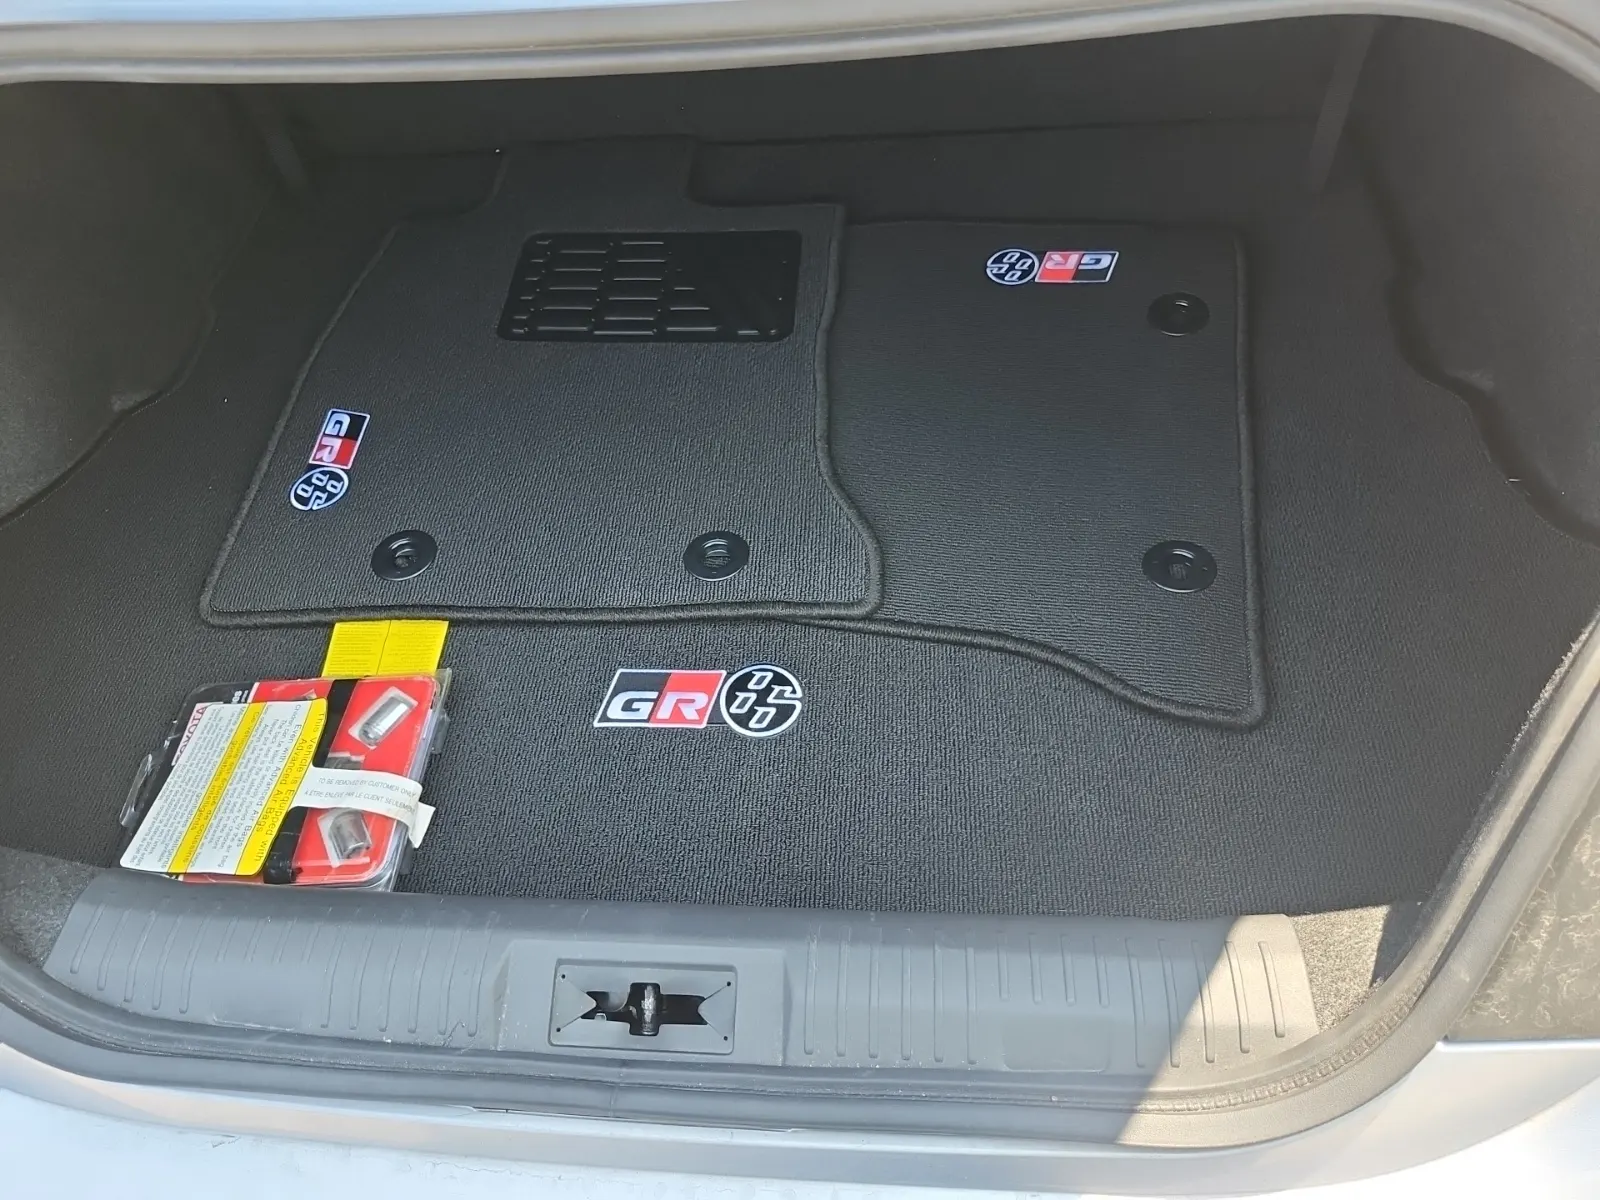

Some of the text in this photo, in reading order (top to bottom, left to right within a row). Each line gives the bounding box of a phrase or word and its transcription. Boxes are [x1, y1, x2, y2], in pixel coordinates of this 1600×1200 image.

[1044, 254, 1112, 270] GR
[316, 412, 350, 462] GR
[606, 690, 709, 720] GR
[234, 724, 302, 847] Even with Advanced Air Bags
[252, 738, 309, 832] Advanced Air Bags
[252, 713, 324, 861] This Vehicle is Equipped with
[364, 793, 384, 802] CLIENT
[368, 780, 400, 791] CUSTOMER
